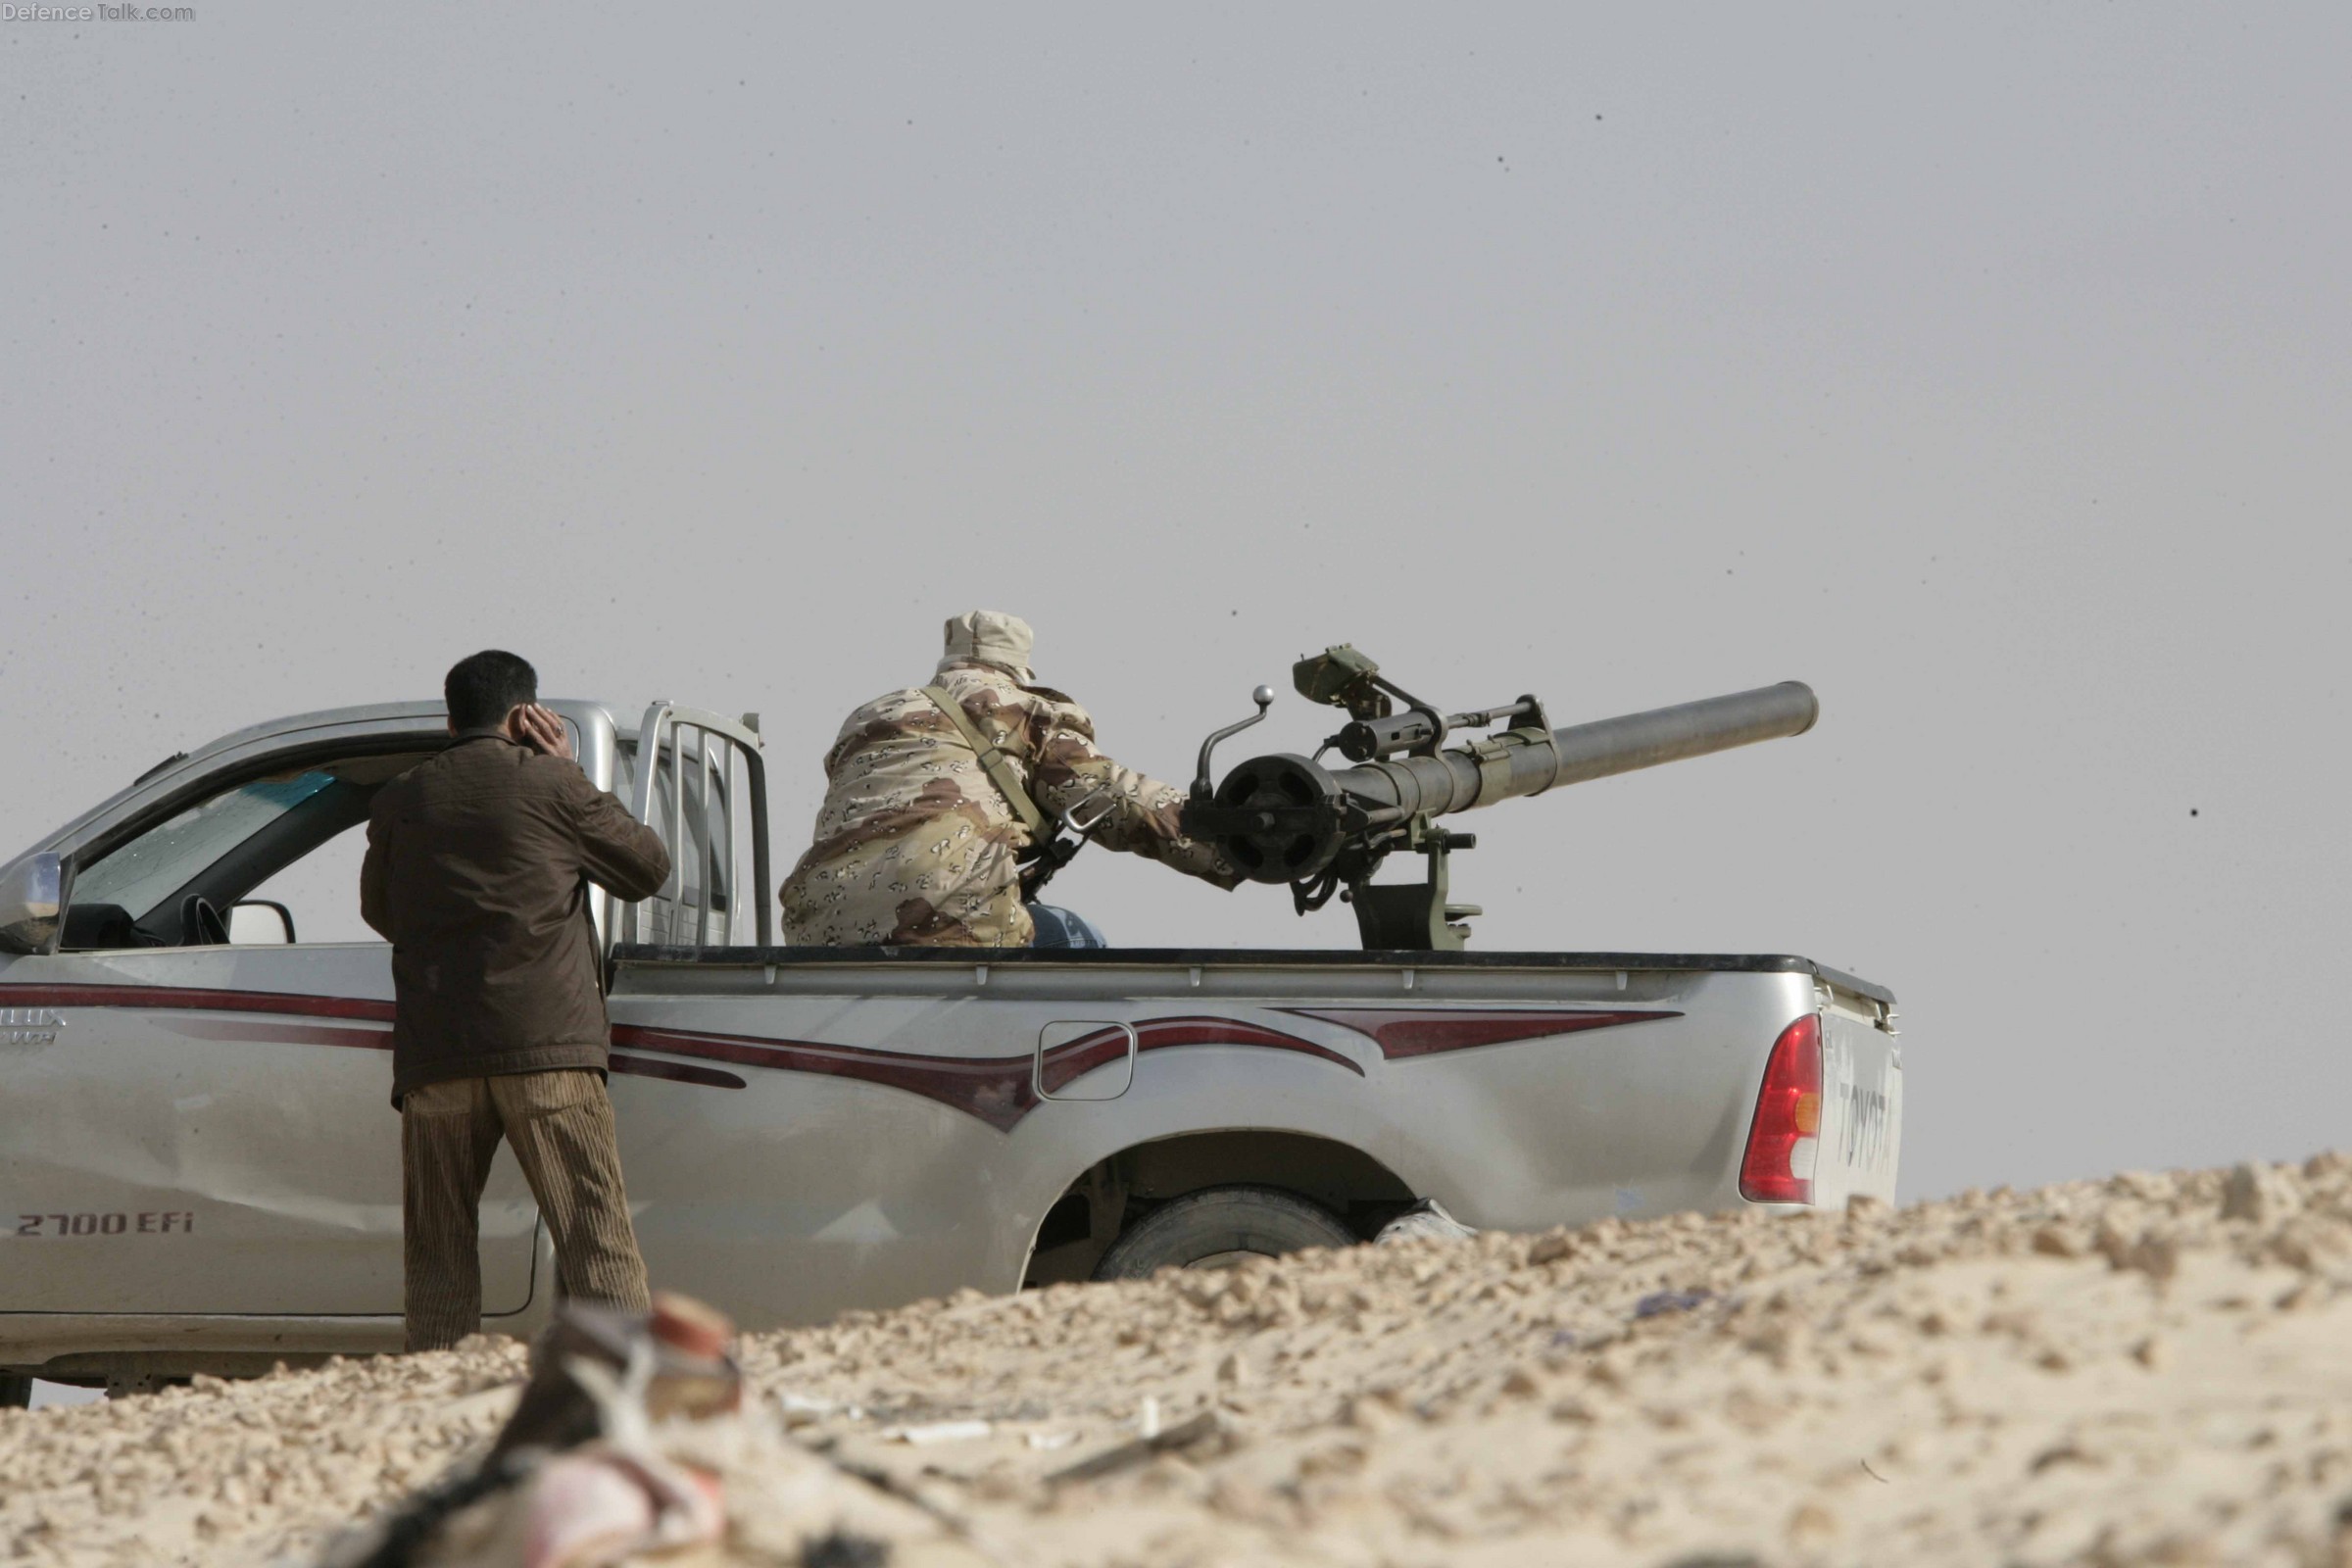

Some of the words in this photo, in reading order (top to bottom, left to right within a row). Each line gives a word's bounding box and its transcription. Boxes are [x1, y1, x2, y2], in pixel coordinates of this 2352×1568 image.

[1838, 1082, 1892, 1175] TOYOTA
[18, 1213, 127, 1236] 2700
[136, 1211, 194, 1233] EFi
